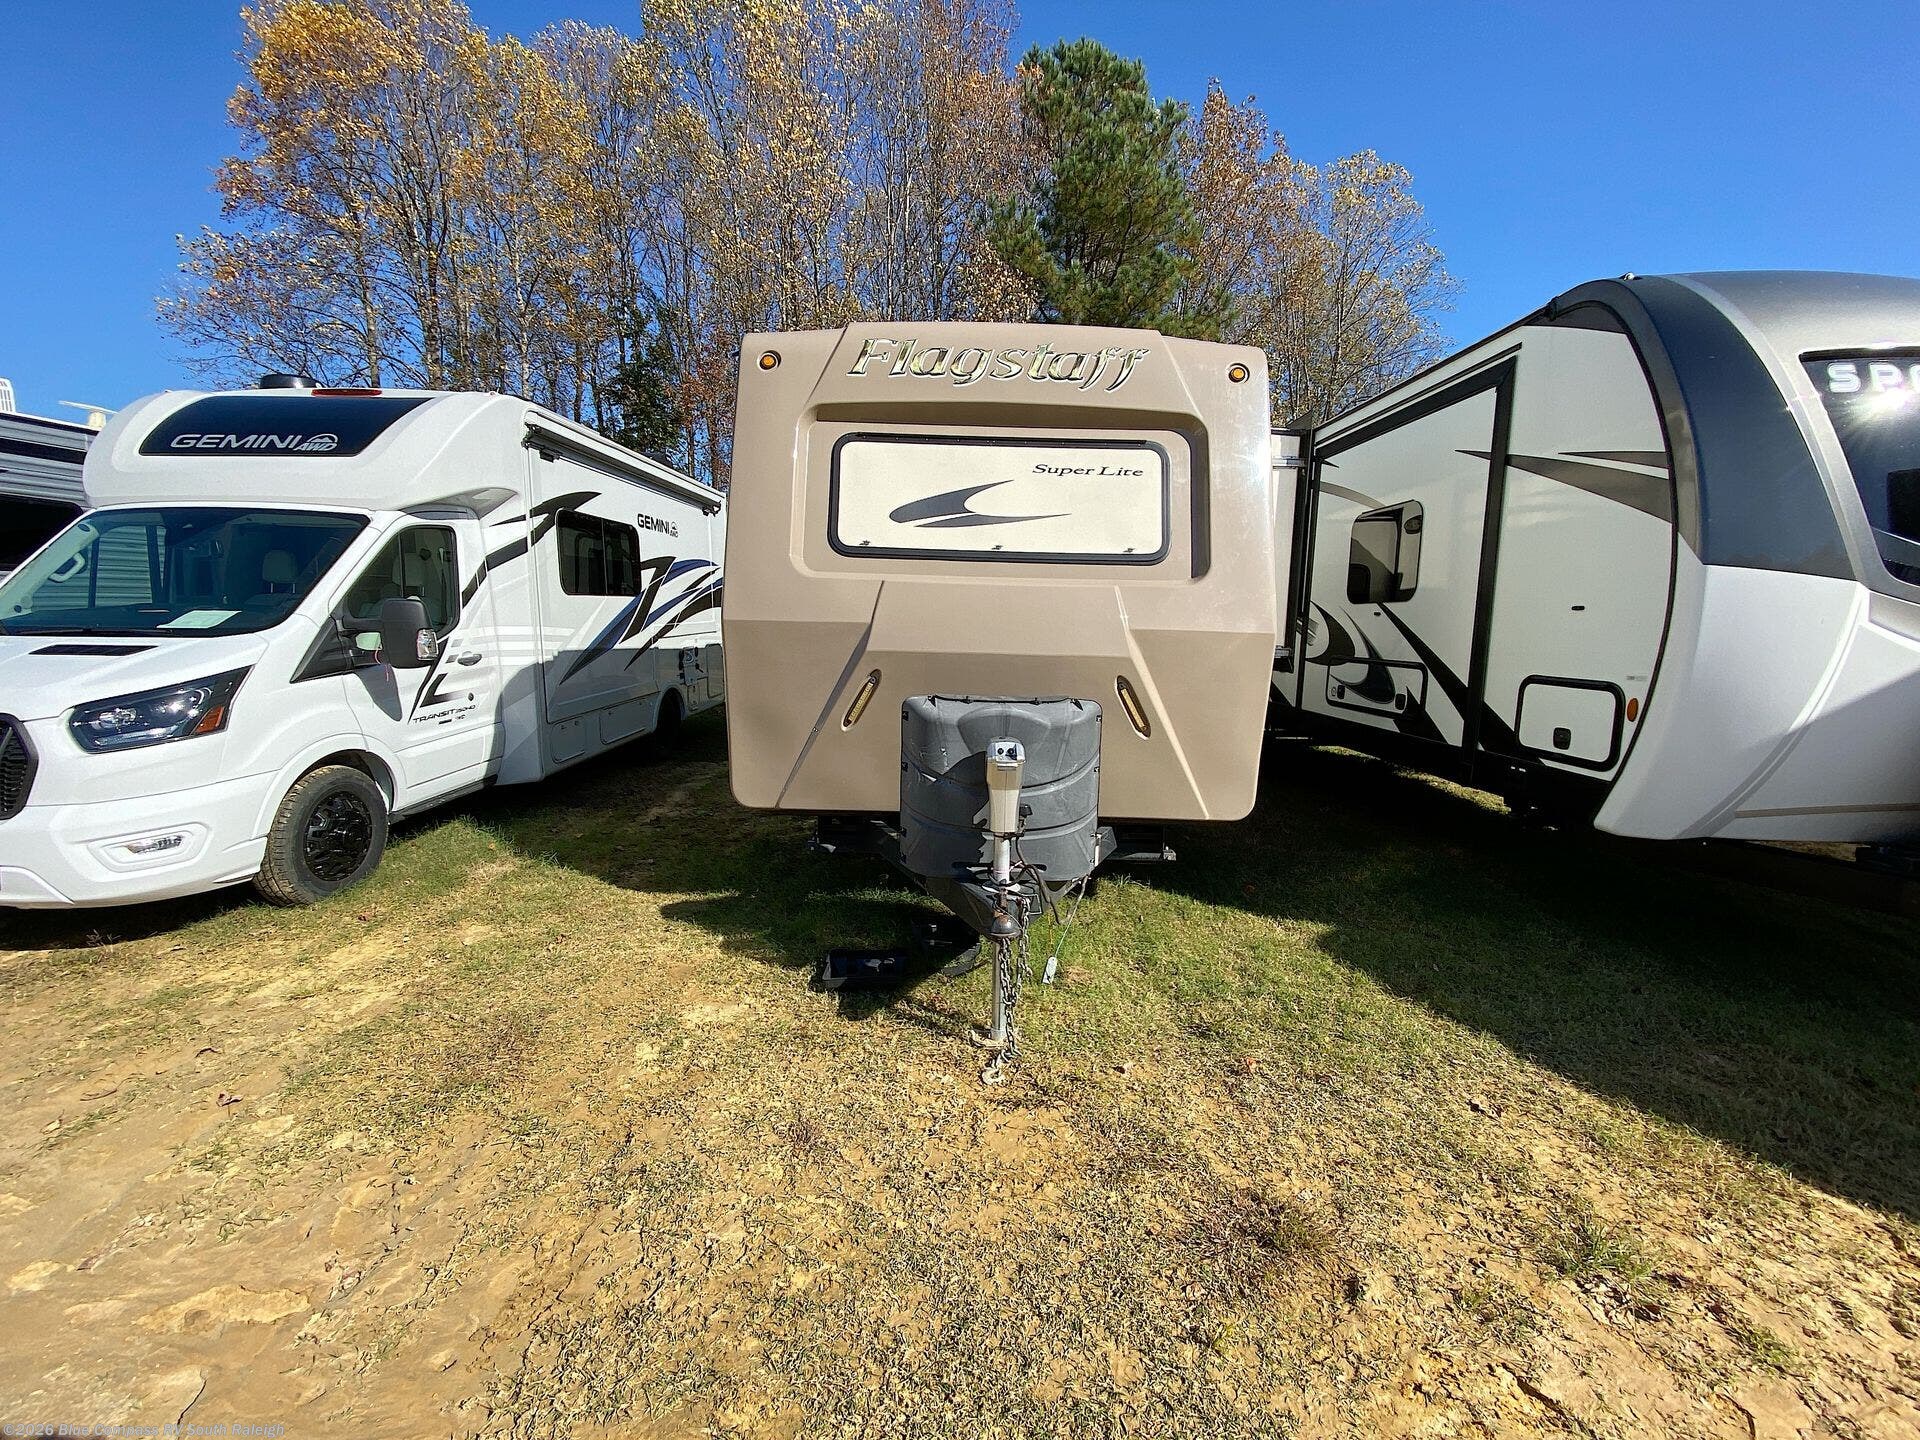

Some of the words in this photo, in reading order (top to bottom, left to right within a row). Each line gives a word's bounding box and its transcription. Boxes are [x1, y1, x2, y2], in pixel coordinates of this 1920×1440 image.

[847, 338, 1150, 393] Flagstaff
[170, 434, 302, 449] GEMINI
[293, 442, 338, 451] AWD
[1032, 463, 1095, 477] Super
[1097, 466, 1144, 477] Lite
[637, 513, 670, 535] GEMINI
